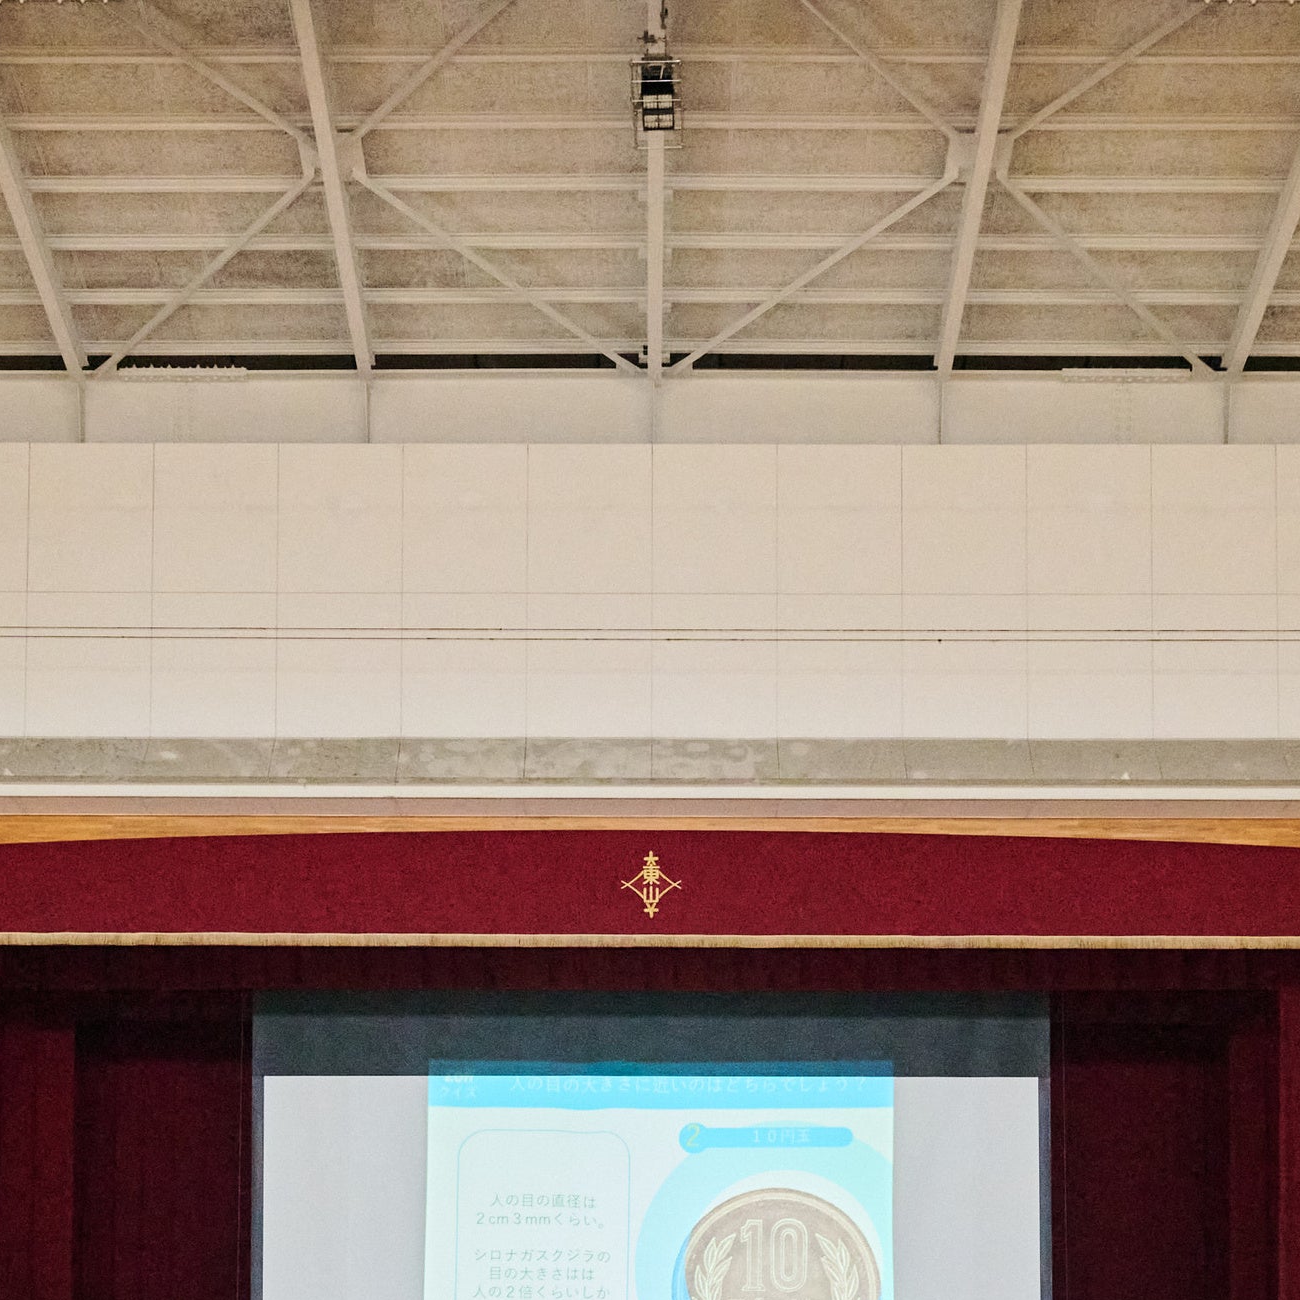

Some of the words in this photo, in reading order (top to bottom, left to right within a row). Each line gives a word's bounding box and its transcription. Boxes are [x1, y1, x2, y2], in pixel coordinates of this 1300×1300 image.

[685, 1122, 700, 1147] 2
[490, 1193, 597, 1209] 人の目の直径は
[474, 1249, 611, 1263] シロナガスクジラの
[740, 1217, 808, 1293] 10
[489, 1266, 595, 1281] 目の大きさはは
